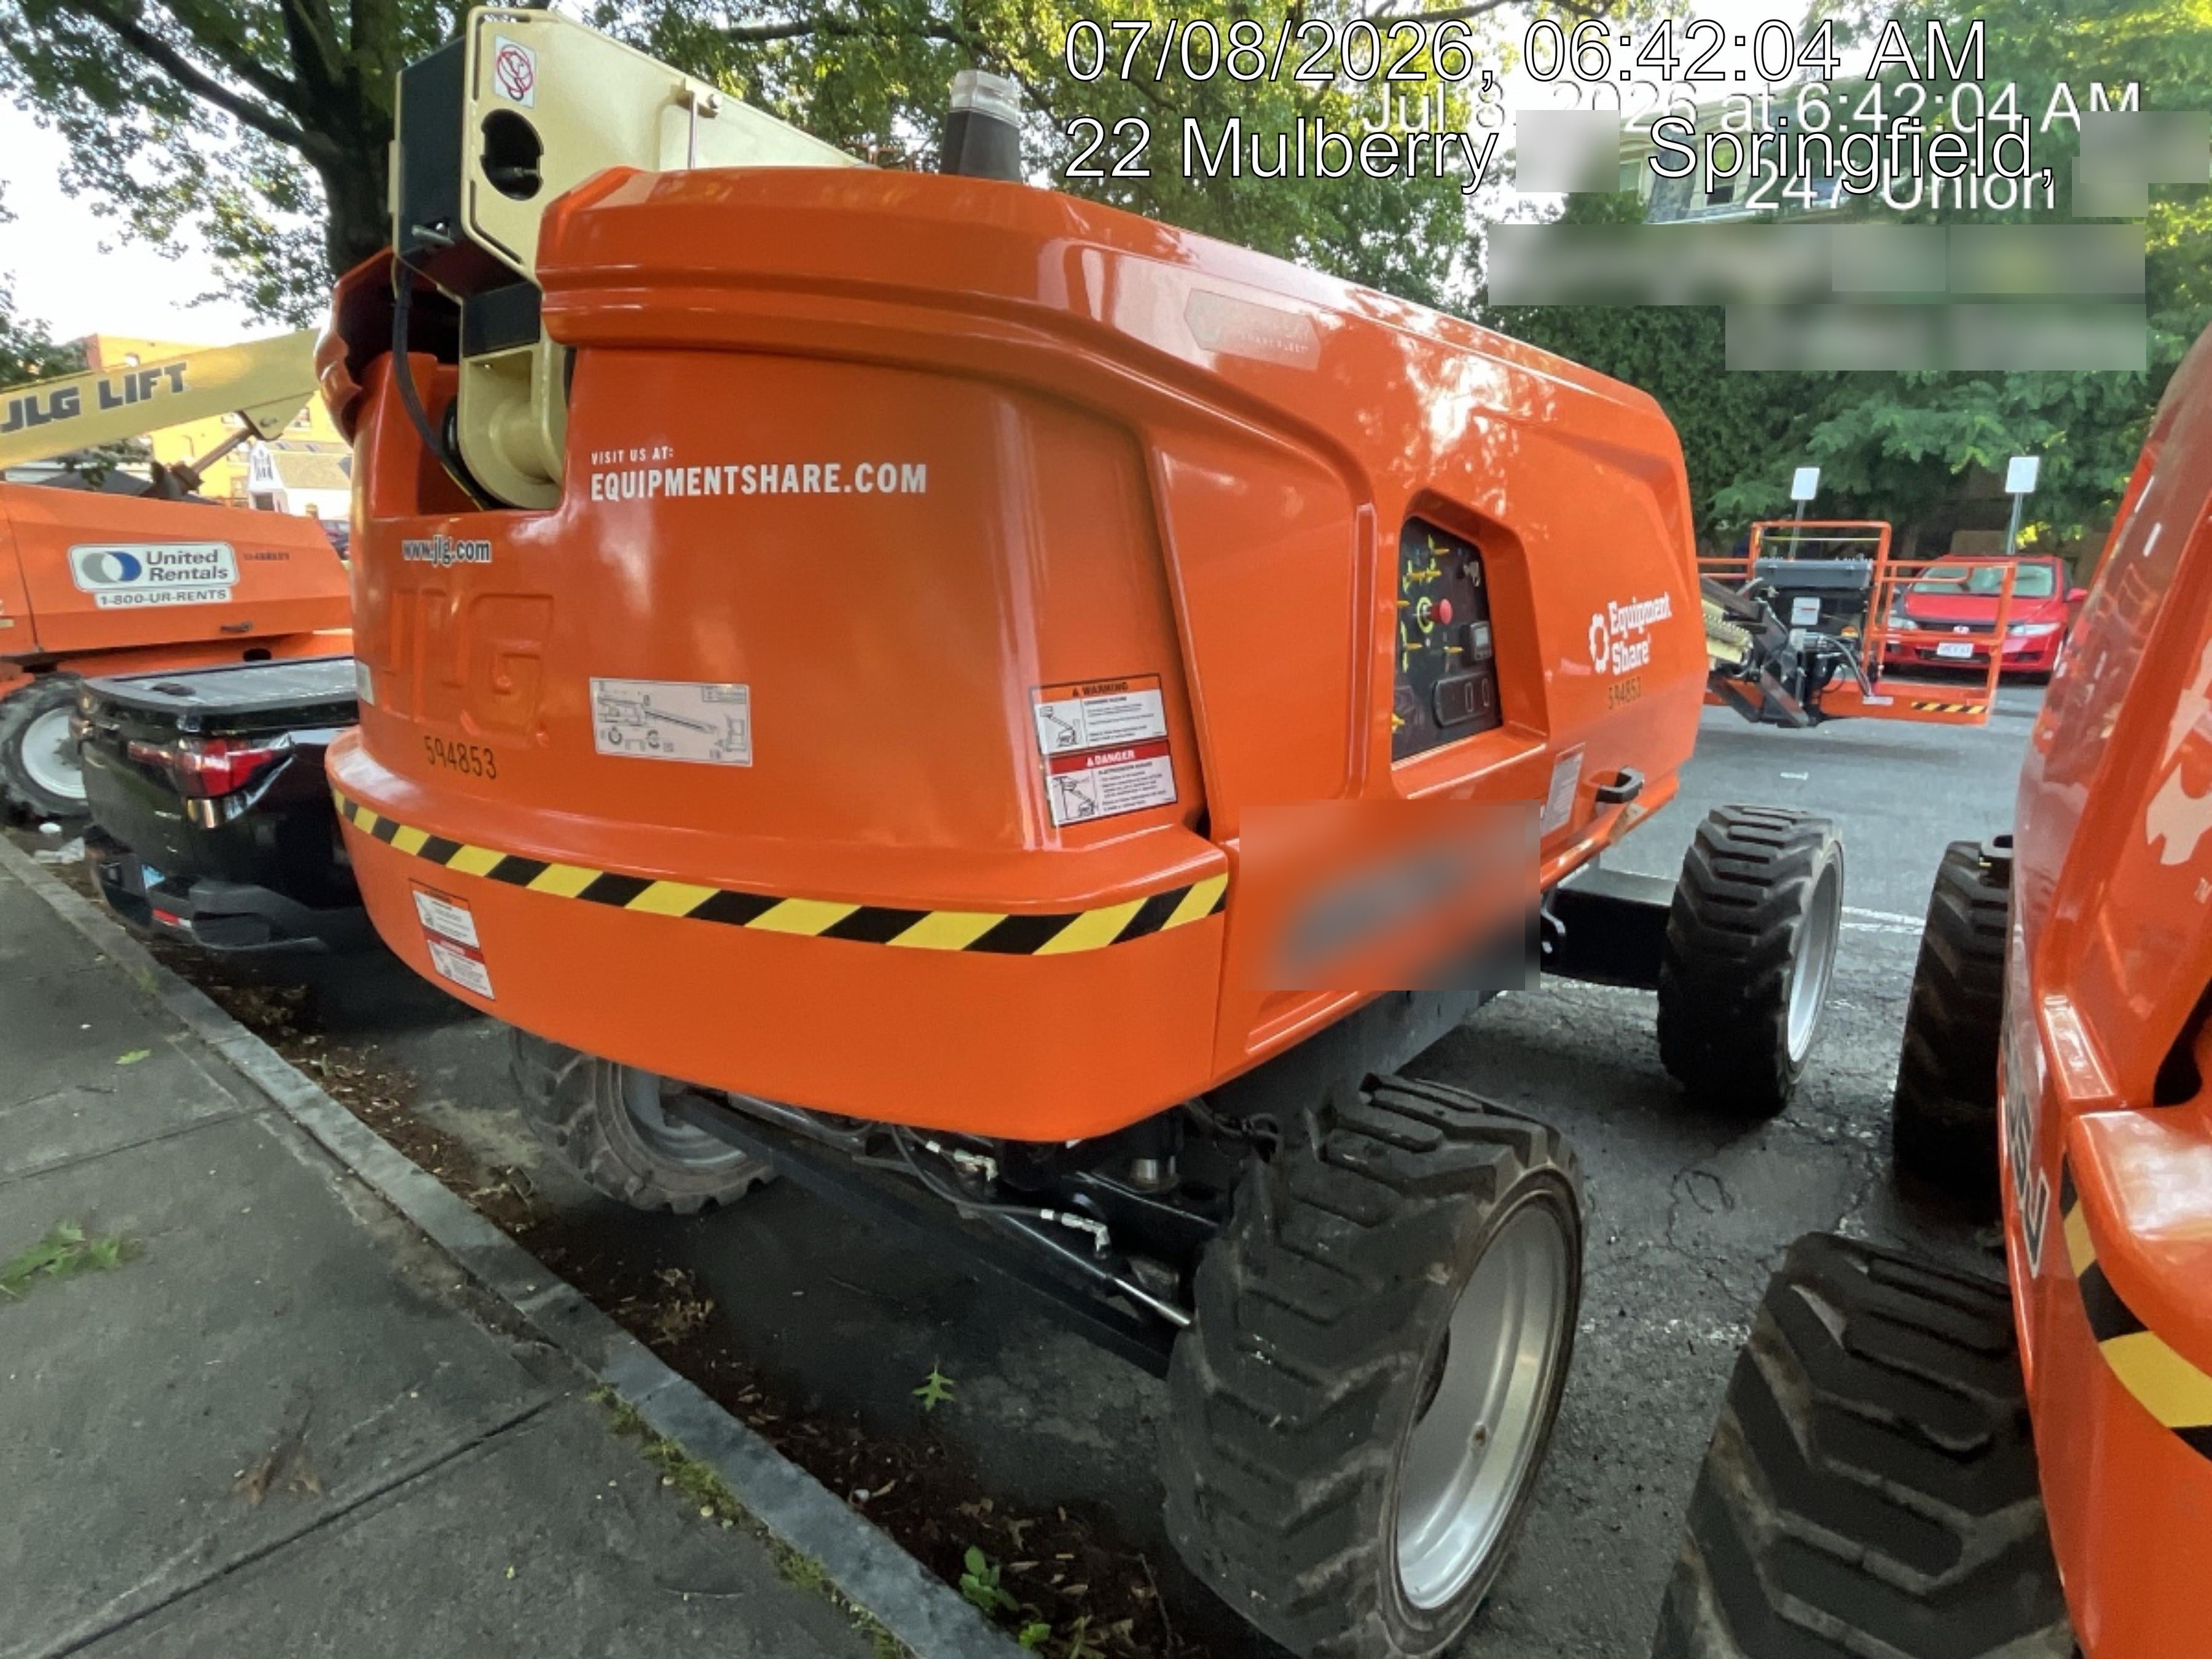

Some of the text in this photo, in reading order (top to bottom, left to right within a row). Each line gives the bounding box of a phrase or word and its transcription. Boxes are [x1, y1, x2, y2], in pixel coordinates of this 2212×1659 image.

[0, 362, 187, 431] JLG LIFT
[591, 446, 673, 465] VISIT US AT:
[590, 462, 928, 502] EQUIPMENTSHARE.COM
[146, 549, 219, 566] United
[401, 534, 492, 568] www.jlg.com
[148, 566, 229, 582] Rentals
[100, 589, 227, 606] 1-800-UR-RENTS
[1607, 590, 1673, 639] Equipment
[1612, 639, 1650, 676] Share
[1081, 681, 1129, 696] WARNING
[424, 735, 497, 780] 594853
[1094, 750, 1135, 766] DANGER
